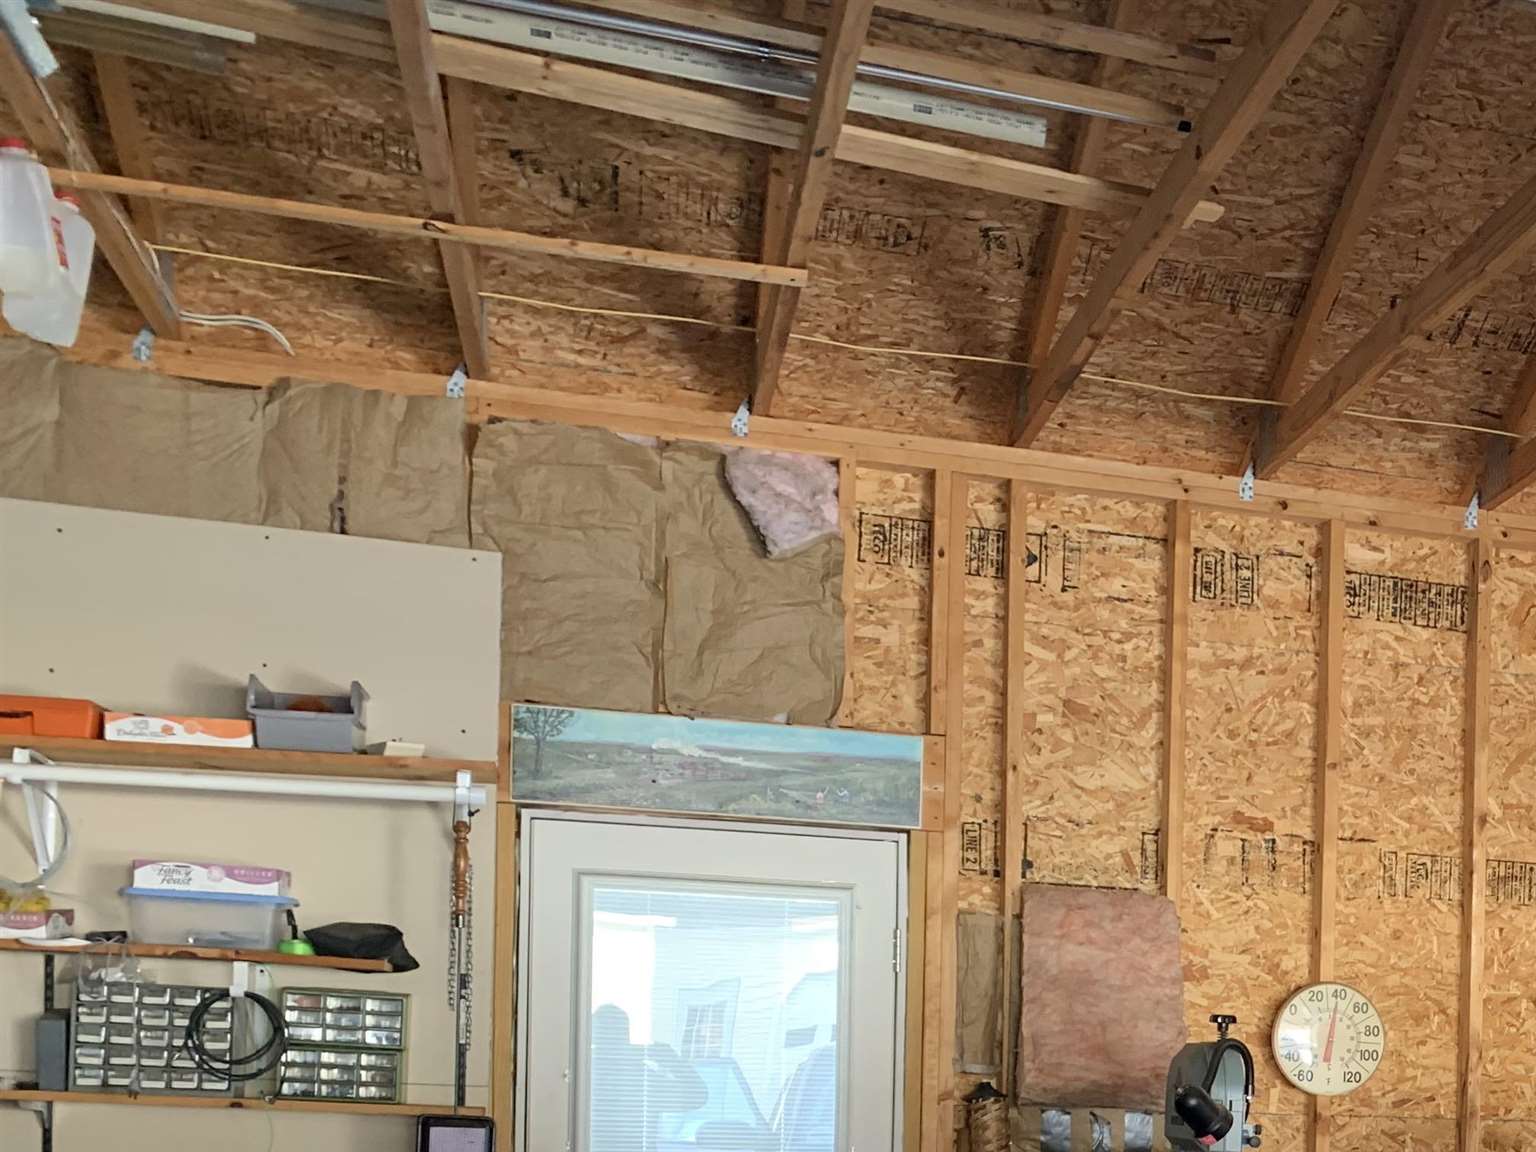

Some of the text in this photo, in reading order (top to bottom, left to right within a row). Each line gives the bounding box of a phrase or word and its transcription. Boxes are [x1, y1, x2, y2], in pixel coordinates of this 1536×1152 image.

[966, 829, 977, 852] LINE
[1308, 990, 1324, 1002] 20
[1331, 988, 1347, 1000] 40
[1289, 1004, 1297, 1015] 0
[1353, 1002, 1369, 1014] 60
[1364, 1025, 1380, 1037] 80
[1360, 1049, 1379, 1062] 100
[1293, 1070, 1314, 1082] -60
[1343, 1071, 1361, 1083] 120
